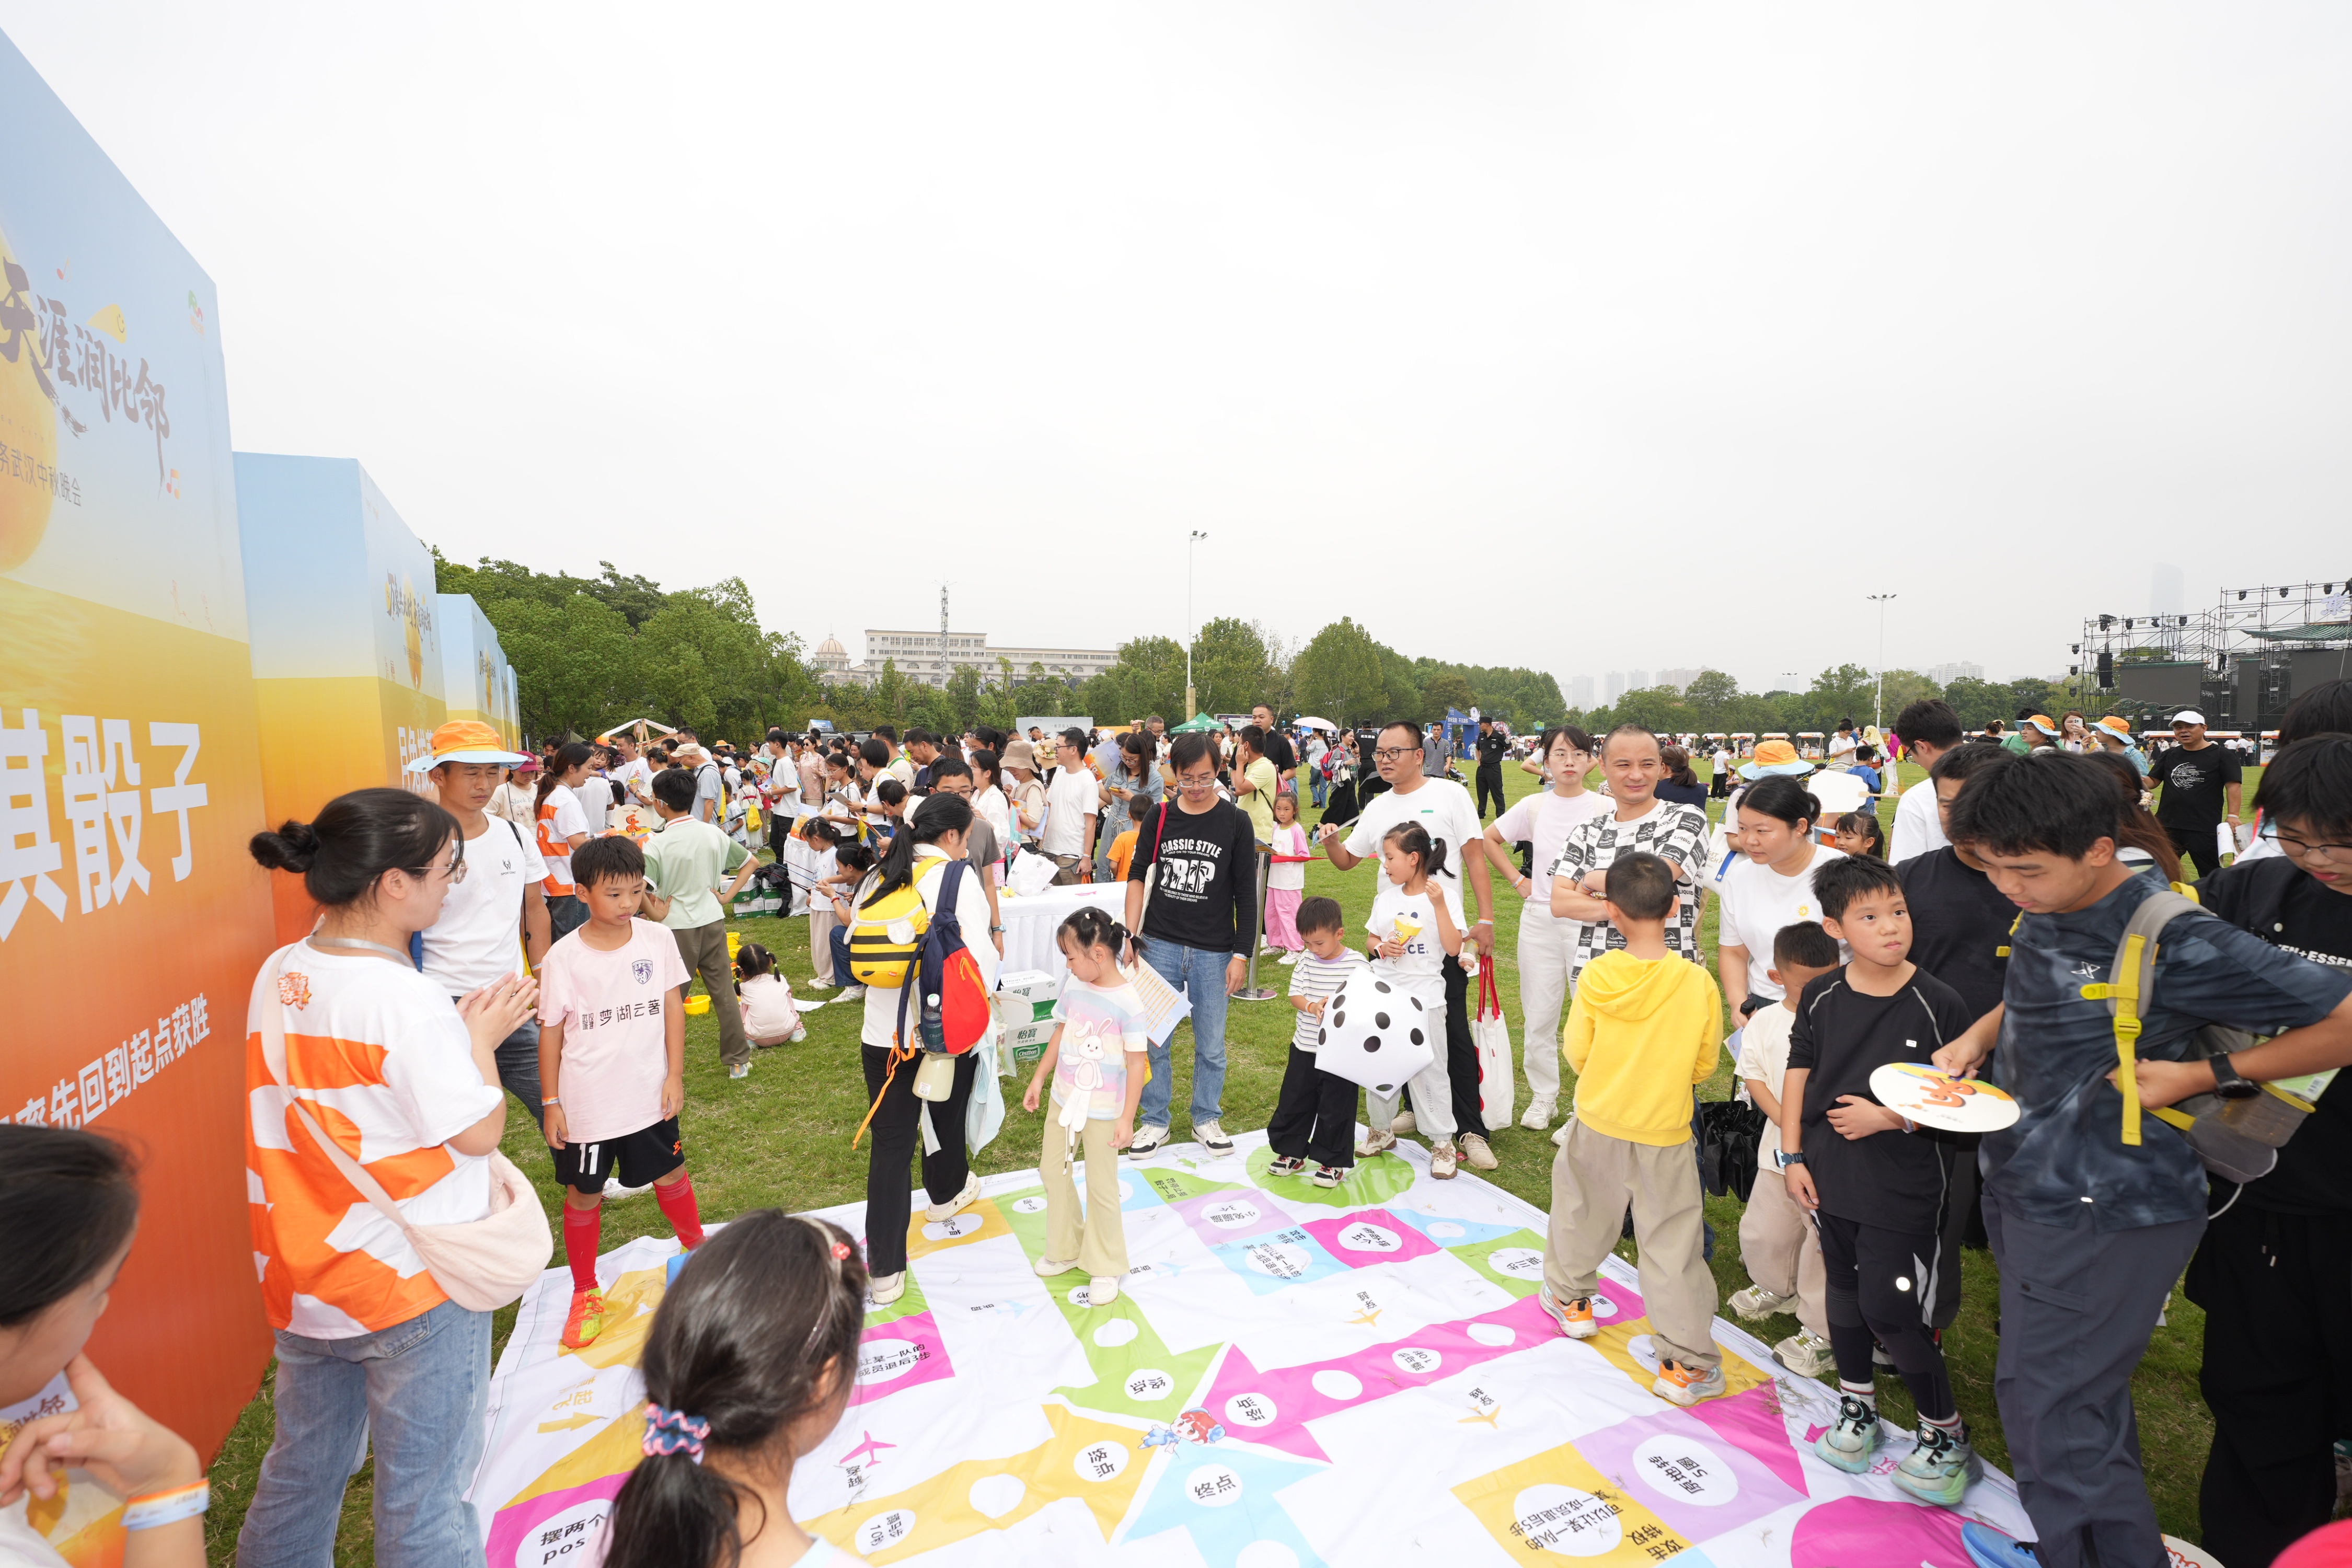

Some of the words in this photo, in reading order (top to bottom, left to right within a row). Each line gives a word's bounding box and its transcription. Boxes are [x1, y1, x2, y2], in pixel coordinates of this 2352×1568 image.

[511, 797, 527, 807] Slack
[1161, 838, 1194, 855] CLASSIC
[1195, 840, 1222, 858] STYLE
[1674, 835, 1691, 844] LIQUID
[1160, 857, 1215, 893] TRIP
[1013, 987, 1031, 997] 怡寶
[582, 1012, 594, 1022] 武汉
[599, 999, 661, 1027] 梦湖云著
[1017, 1028, 1037, 1040] 怡寶
[0, 992, 210, 1131] 率先回到起点获胜
[579, 1143, 599, 1175] 11
[1154, 1180, 1177, 1200] 骰子一局
[1023, 1198, 1038, 1211] 退一步
[1210, 1211, 1256, 1223] 小兔蹦蹦
[1275, 1233, 1295, 1244] 特权
[1289, 1230, 1307, 1241] 攻击
[1351, 1232, 1371, 1244] 五个
[1361, 1227, 1391, 1247] 俯卧撑
[1246, 1244, 1292, 1280] 某一成员退后5步
[1260, 1242, 1302, 1277] 可以让某一队的
[1506, 1256, 1542, 1271] 退三步
[1356, 1291, 1377, 1309] 穿越
[1592, 1297, 1610, 1307] 退一
[858, 1351, 931, 1378] 成员退后3步
[859, 1343, 926, 1366] 让某一队的
[1412, 1350, 1432, 1364] 10秒
[1130, 1376, 1167, 1394] 终点
[552, 1389, 594, 1411] 起飞
[1469, 1387, 1494, 1406] 穿越
[1237, 1396, 1266, 1422] 终点
[1088, 1448, 1115, 1478] 终点
[1676, 1457, 1709, 1478] 5圈
[846, 1465, 863, 1489] 穿越
[1647, 1456, 1705, 1494] 原地转
[1195, 1473, 1237, 1500] 终点
[1509, 1490, 1610, 1537] 某一成员退后5步
[540, 1514, 608, 1547] 摆两个
[870, 1524, 884, 1546] 10秒
[1525, 1504, 1624, 1551] 可以让某一队的
[1626, 1524, 1664, 1546] 特权
[543, 1538, 586, 1565] pos
[1645, 1539, 1684, 1561] 攻击
